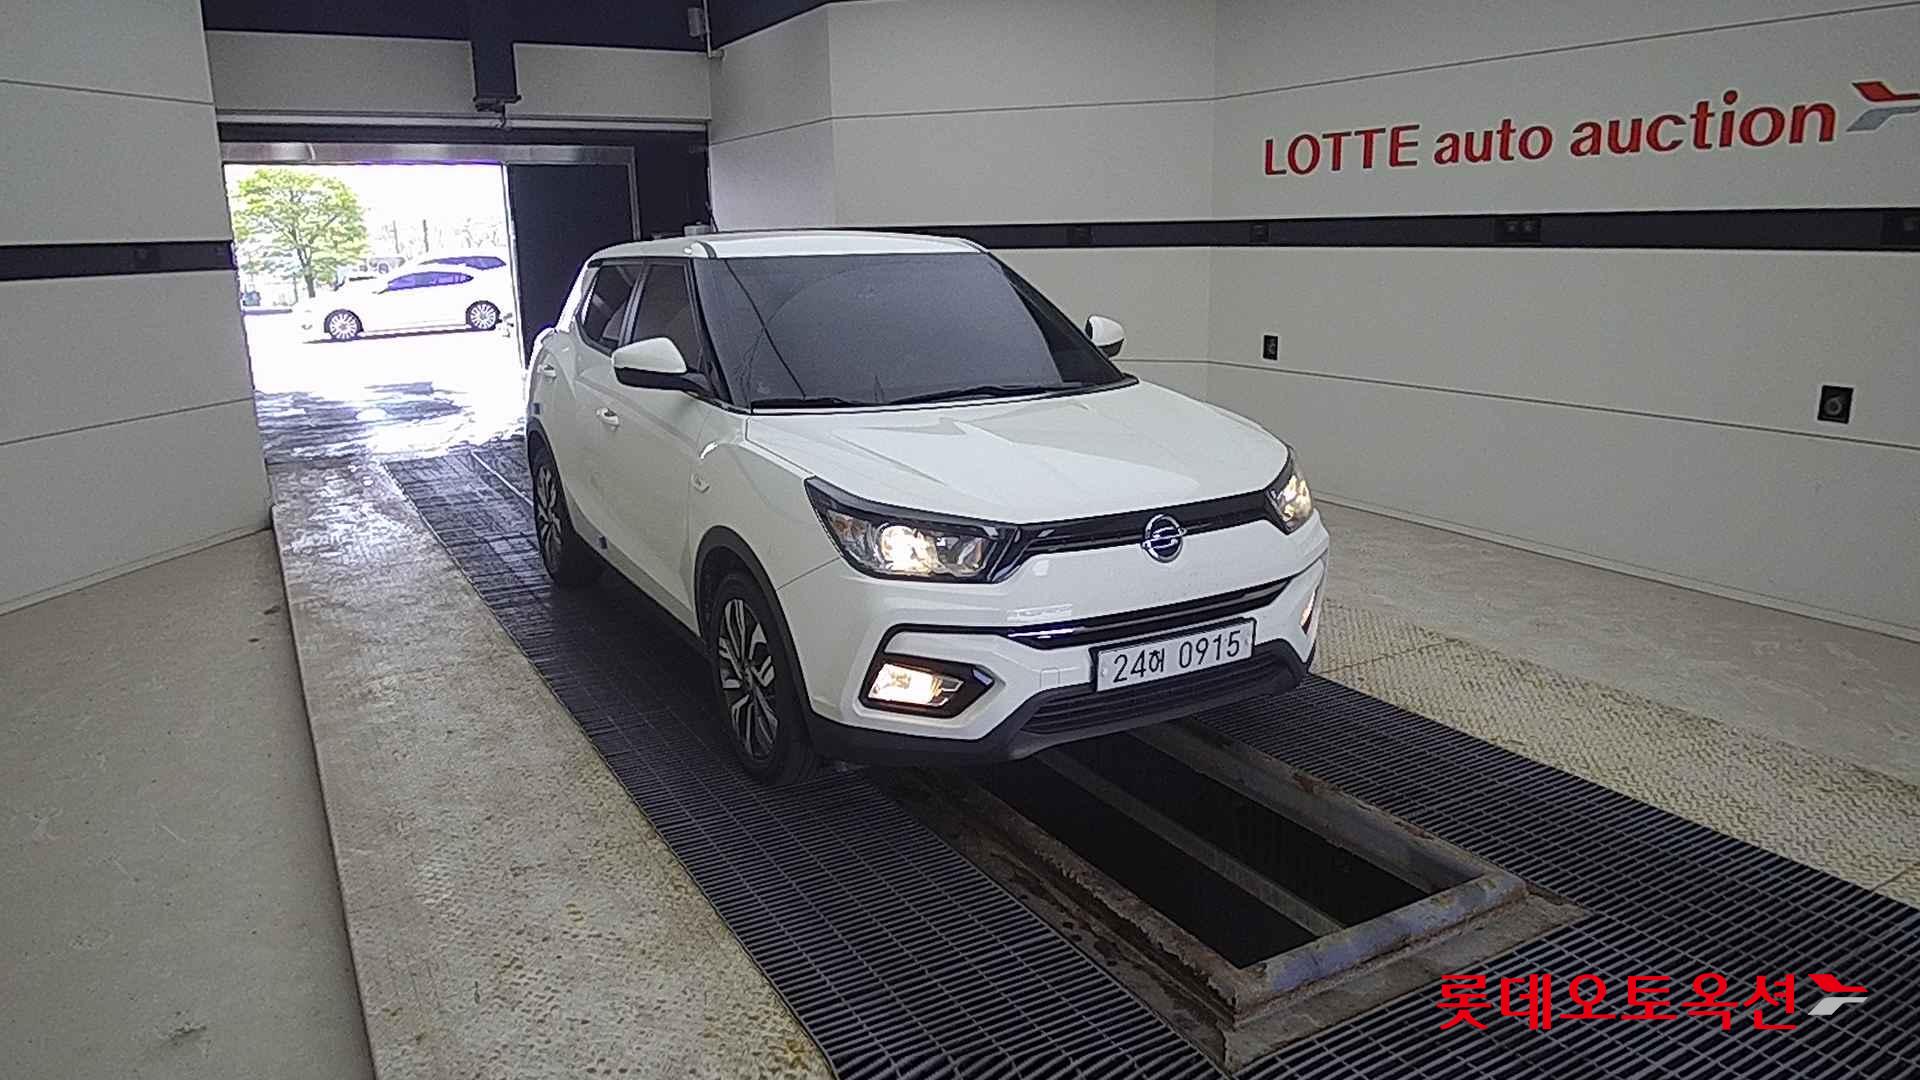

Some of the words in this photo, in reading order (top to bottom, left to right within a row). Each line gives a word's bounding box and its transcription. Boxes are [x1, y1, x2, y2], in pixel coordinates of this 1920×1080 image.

[1264, 124, 1421, 176] LOTTE
[1433, 118, 1553, 165] auto
[1570, 90, 1836, 157] auction
[1112, 647, 1165, 683] 24허
[1178, 630, 1241, 669] 0915
